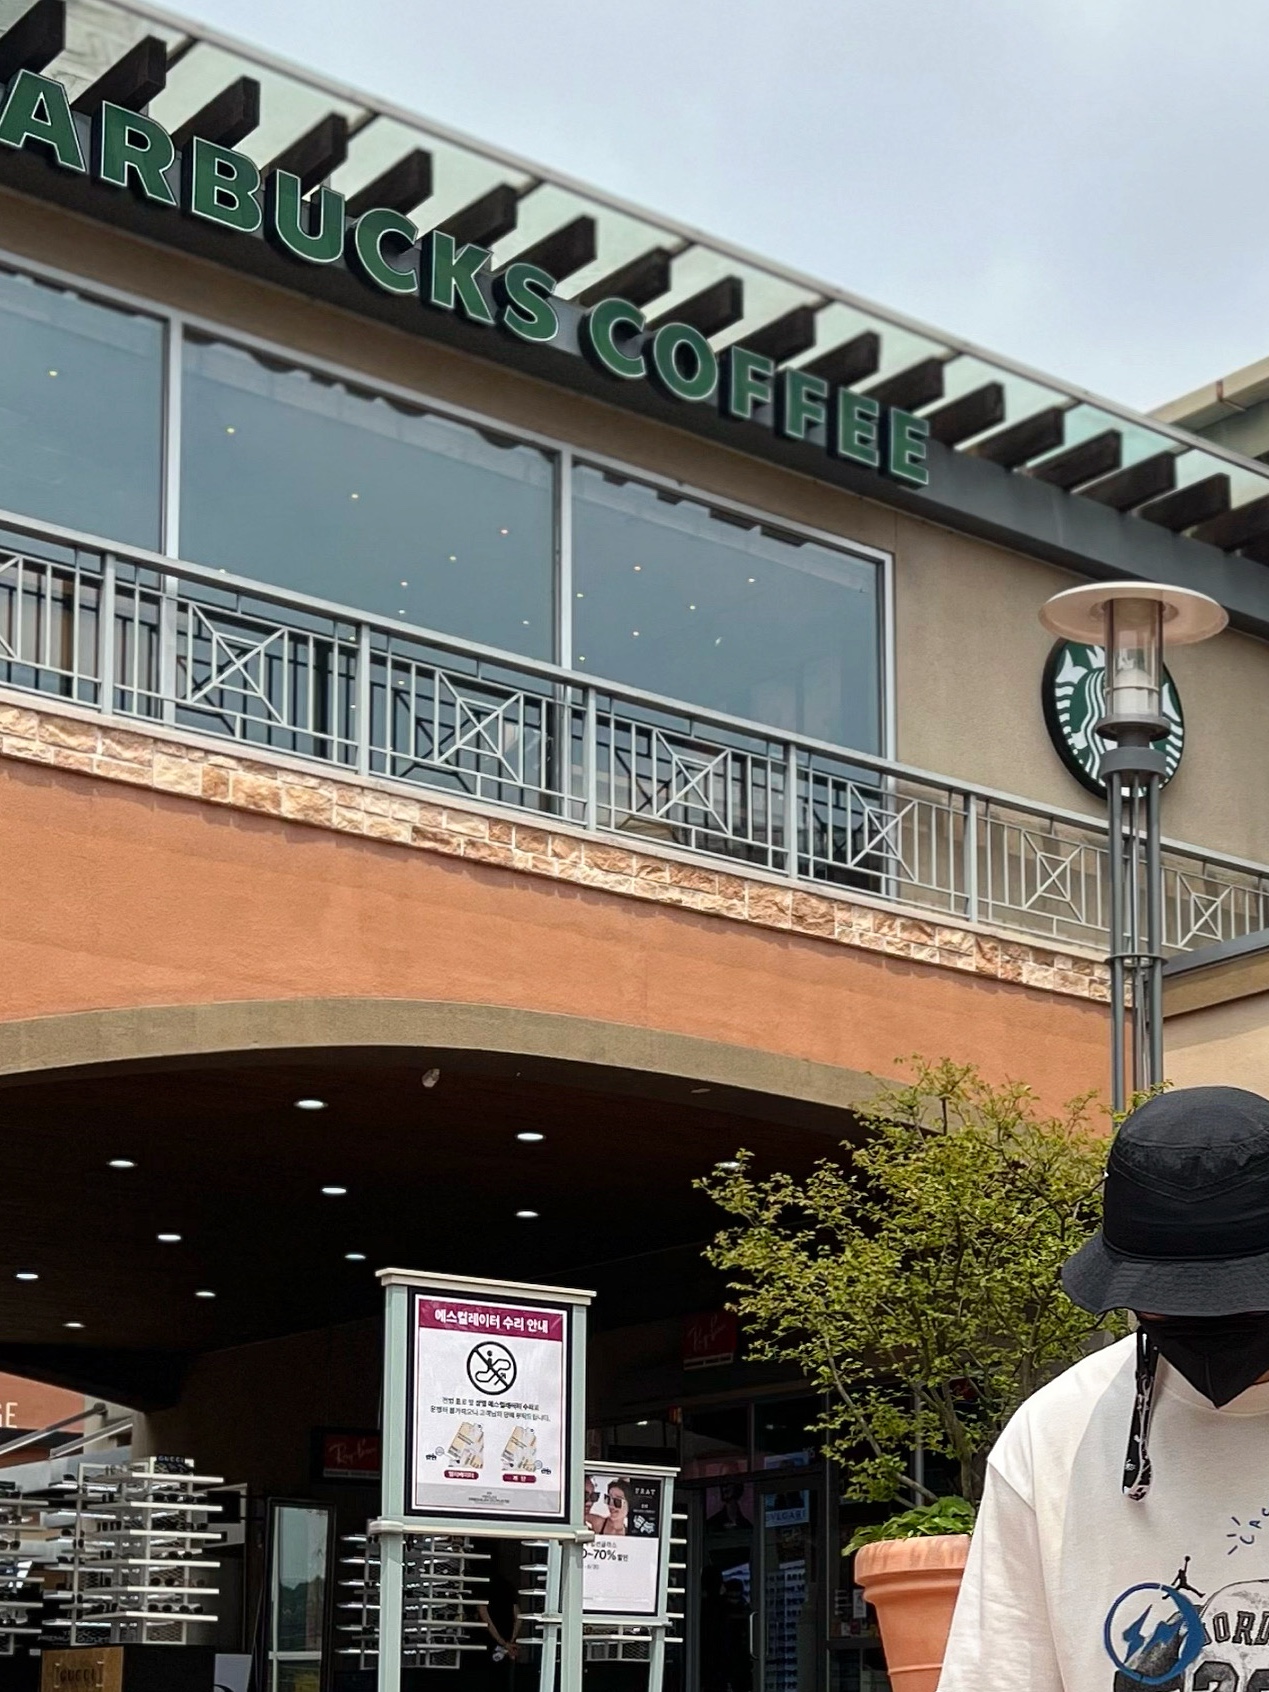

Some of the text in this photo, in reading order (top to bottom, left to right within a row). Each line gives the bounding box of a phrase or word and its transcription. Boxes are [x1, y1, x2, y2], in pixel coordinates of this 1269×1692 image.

[588, 297, 931, 487] COFFEE
[434, 1309, 549, 1334] 에스컬레이터 수리 안내
